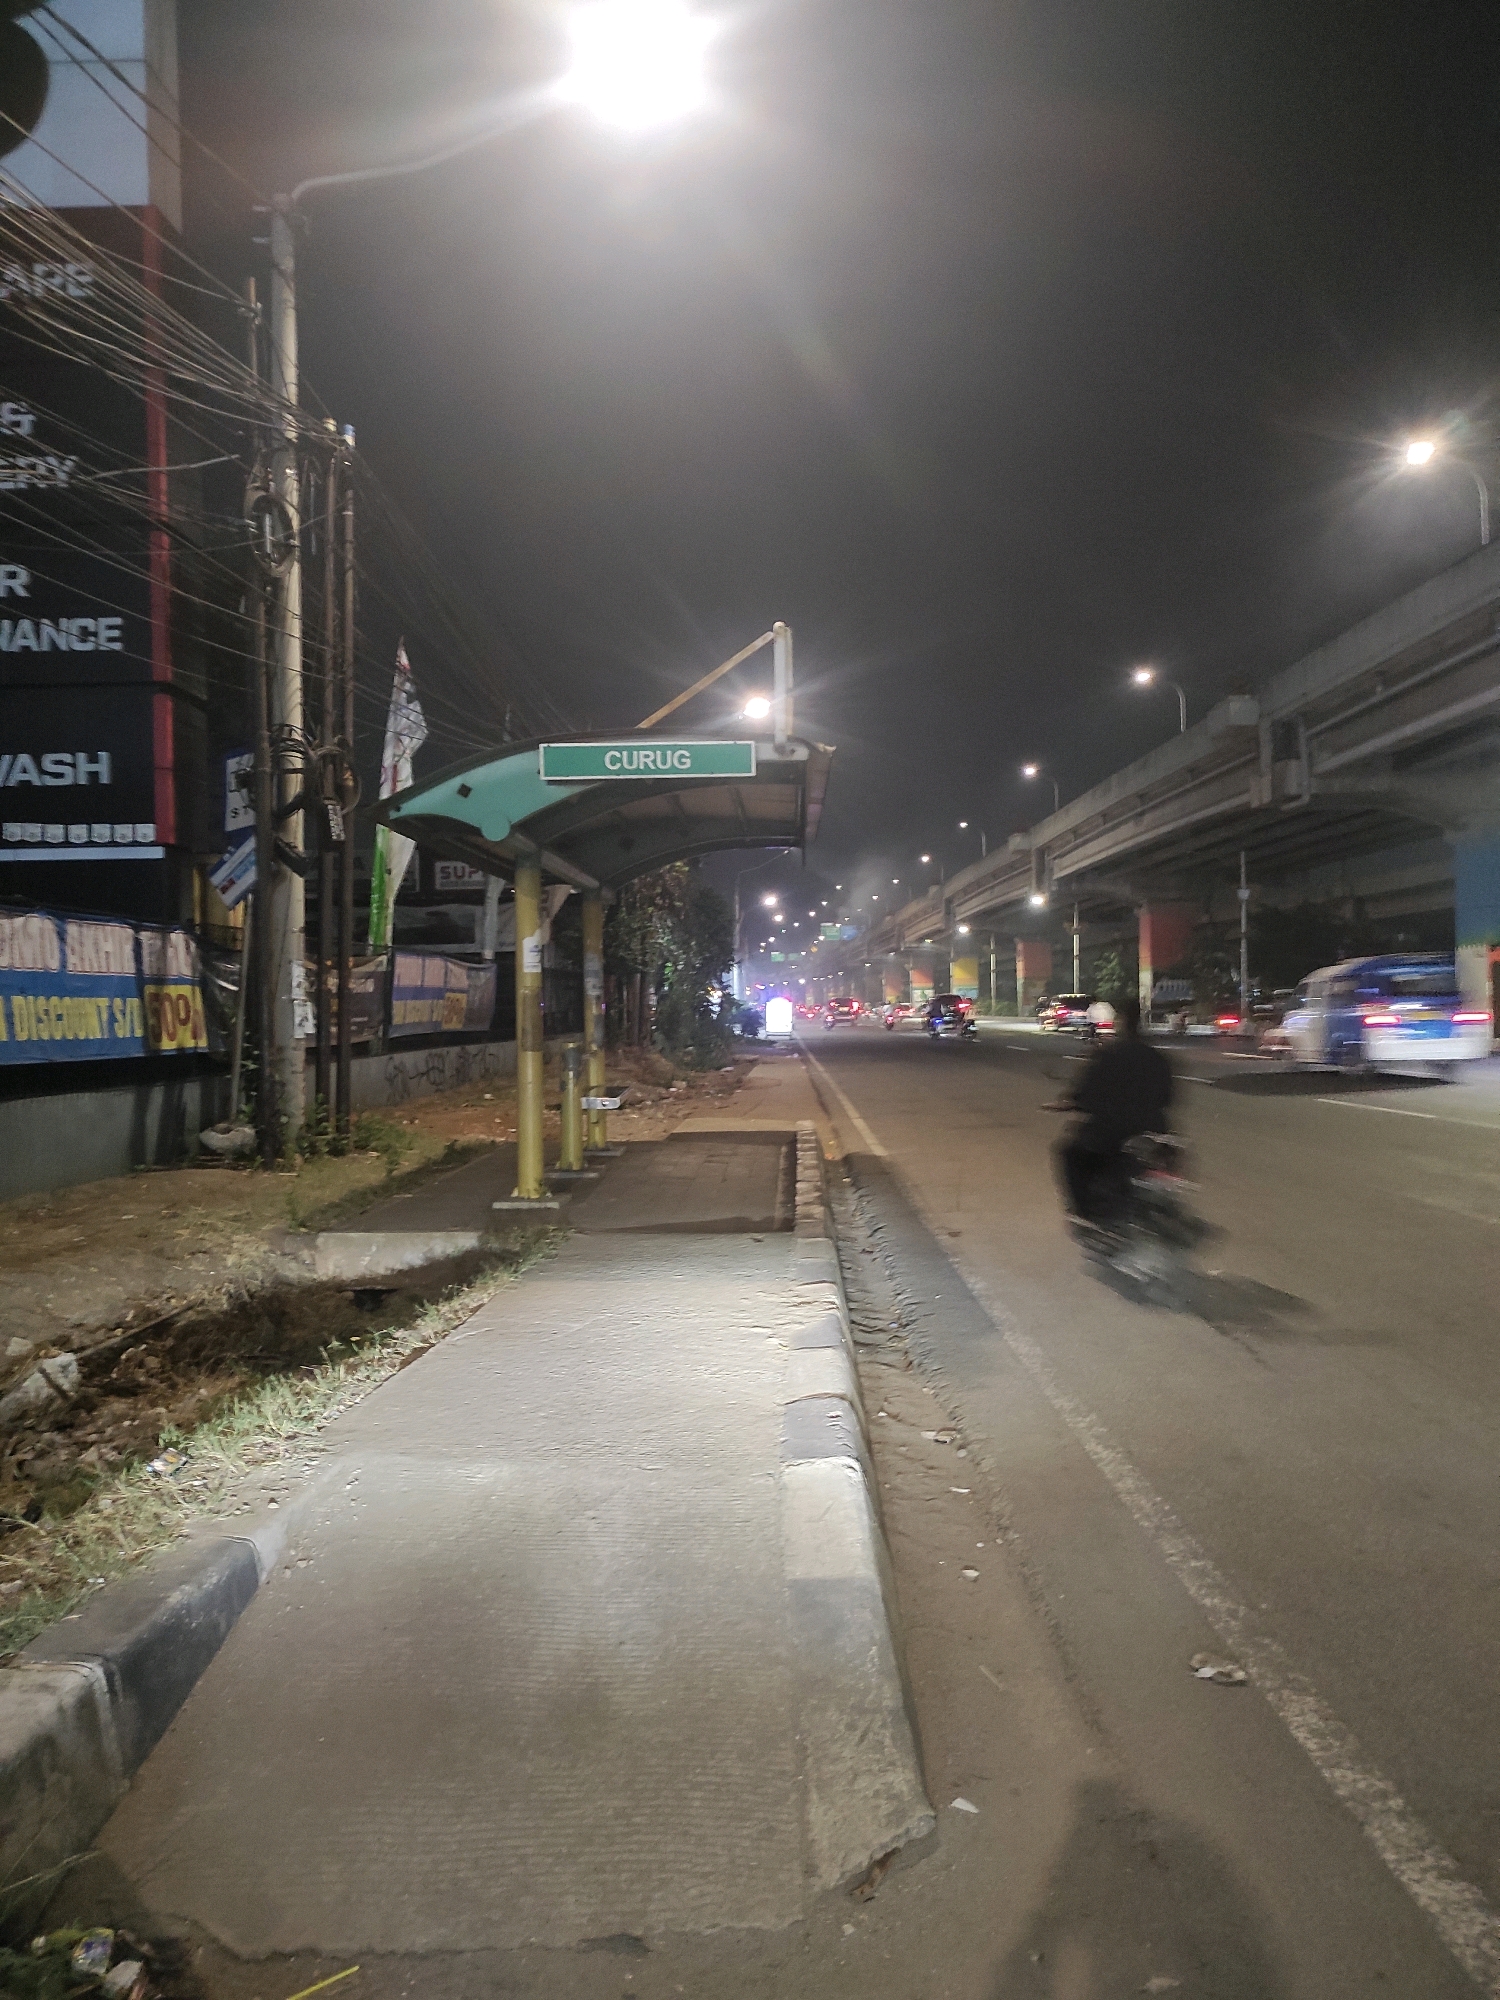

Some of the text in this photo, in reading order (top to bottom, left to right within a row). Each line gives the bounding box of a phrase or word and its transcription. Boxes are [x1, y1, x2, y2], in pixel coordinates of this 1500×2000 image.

[0, 564, 31, 598] R
[604, 750, 692, 770] CURUG
[11, 995, 109, 1041] DISCOUNT
